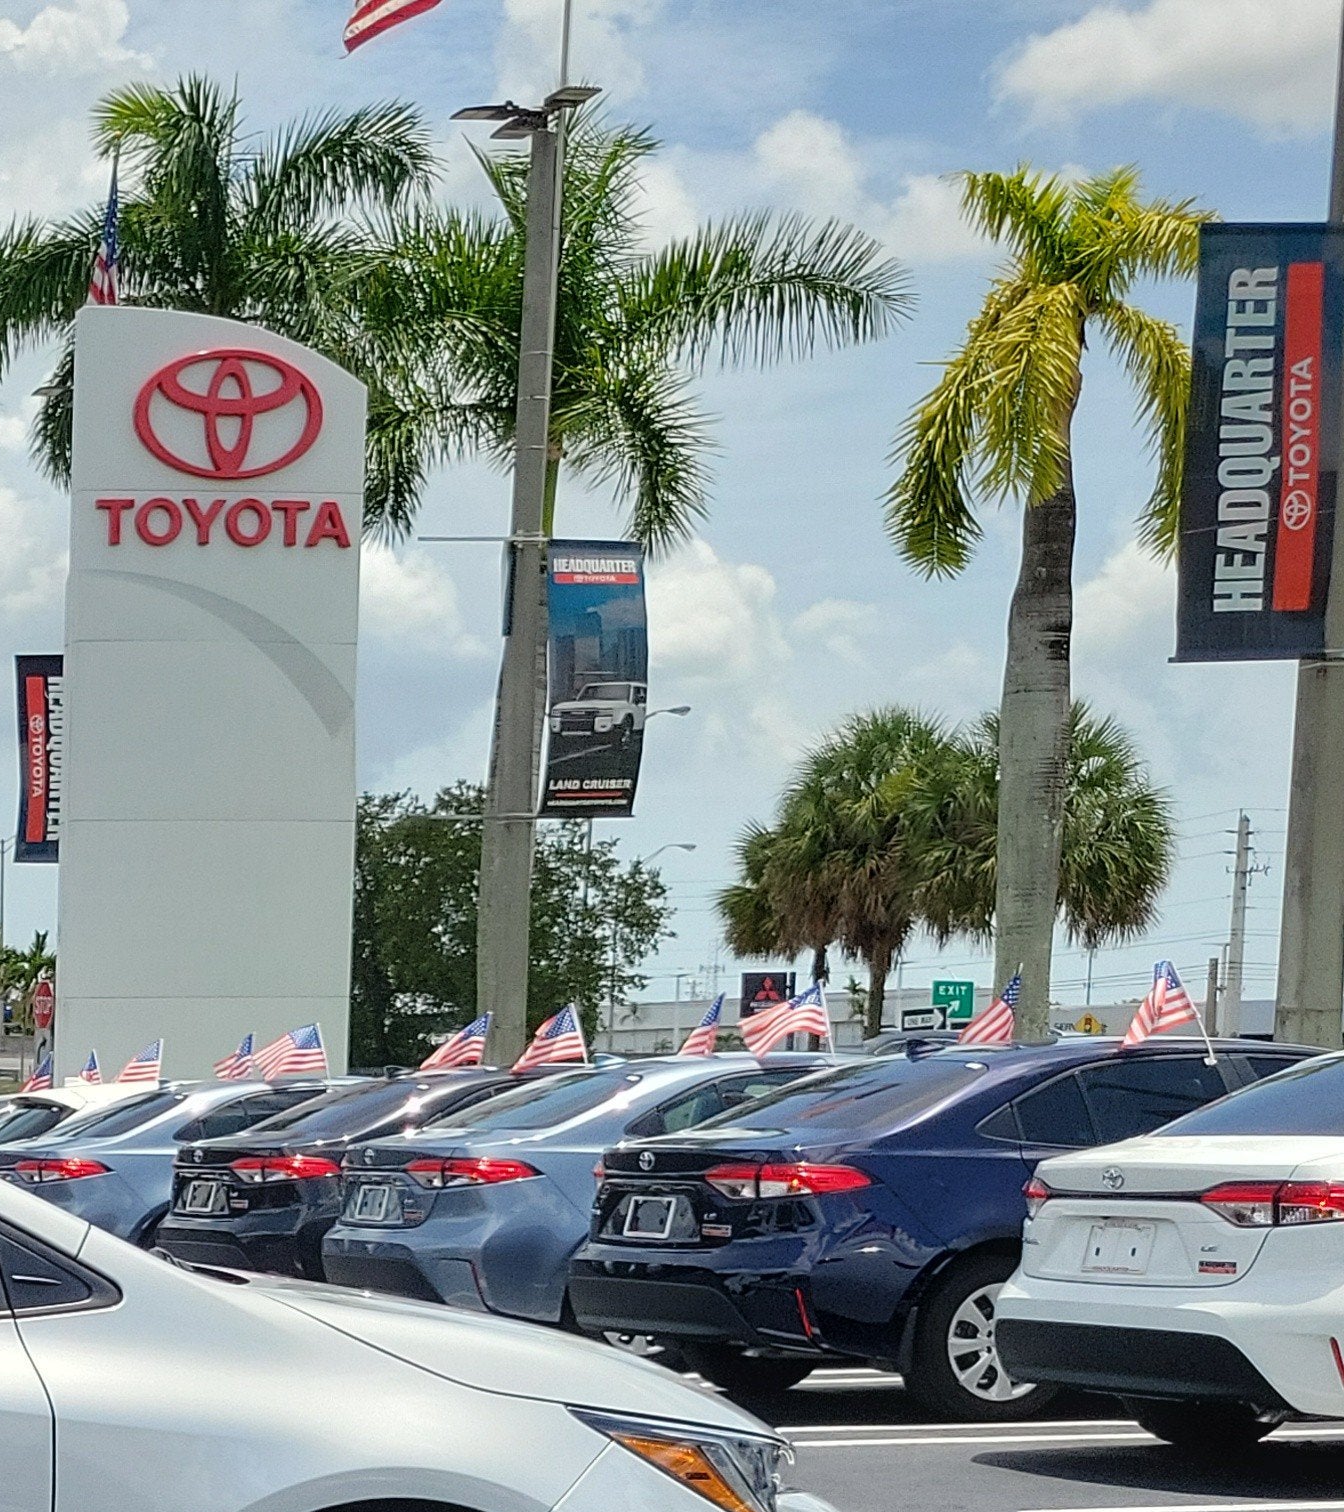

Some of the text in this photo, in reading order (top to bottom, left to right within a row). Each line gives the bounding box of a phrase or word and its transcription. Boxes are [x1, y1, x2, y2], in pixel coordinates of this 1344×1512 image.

[1212, 265, 1281, 613] HEADQUARTER
[1287, 356, 1314, 486] TOYOTA
[95, 497, 352, 549] TOYOTA
[553, 557, 637, 574] HEADQUARTER
[31, 736, 44, 798] TOYOTA
[548, 778, 632, 791] LAND CRUISER
[938, 985, 968, 996] EXIT
